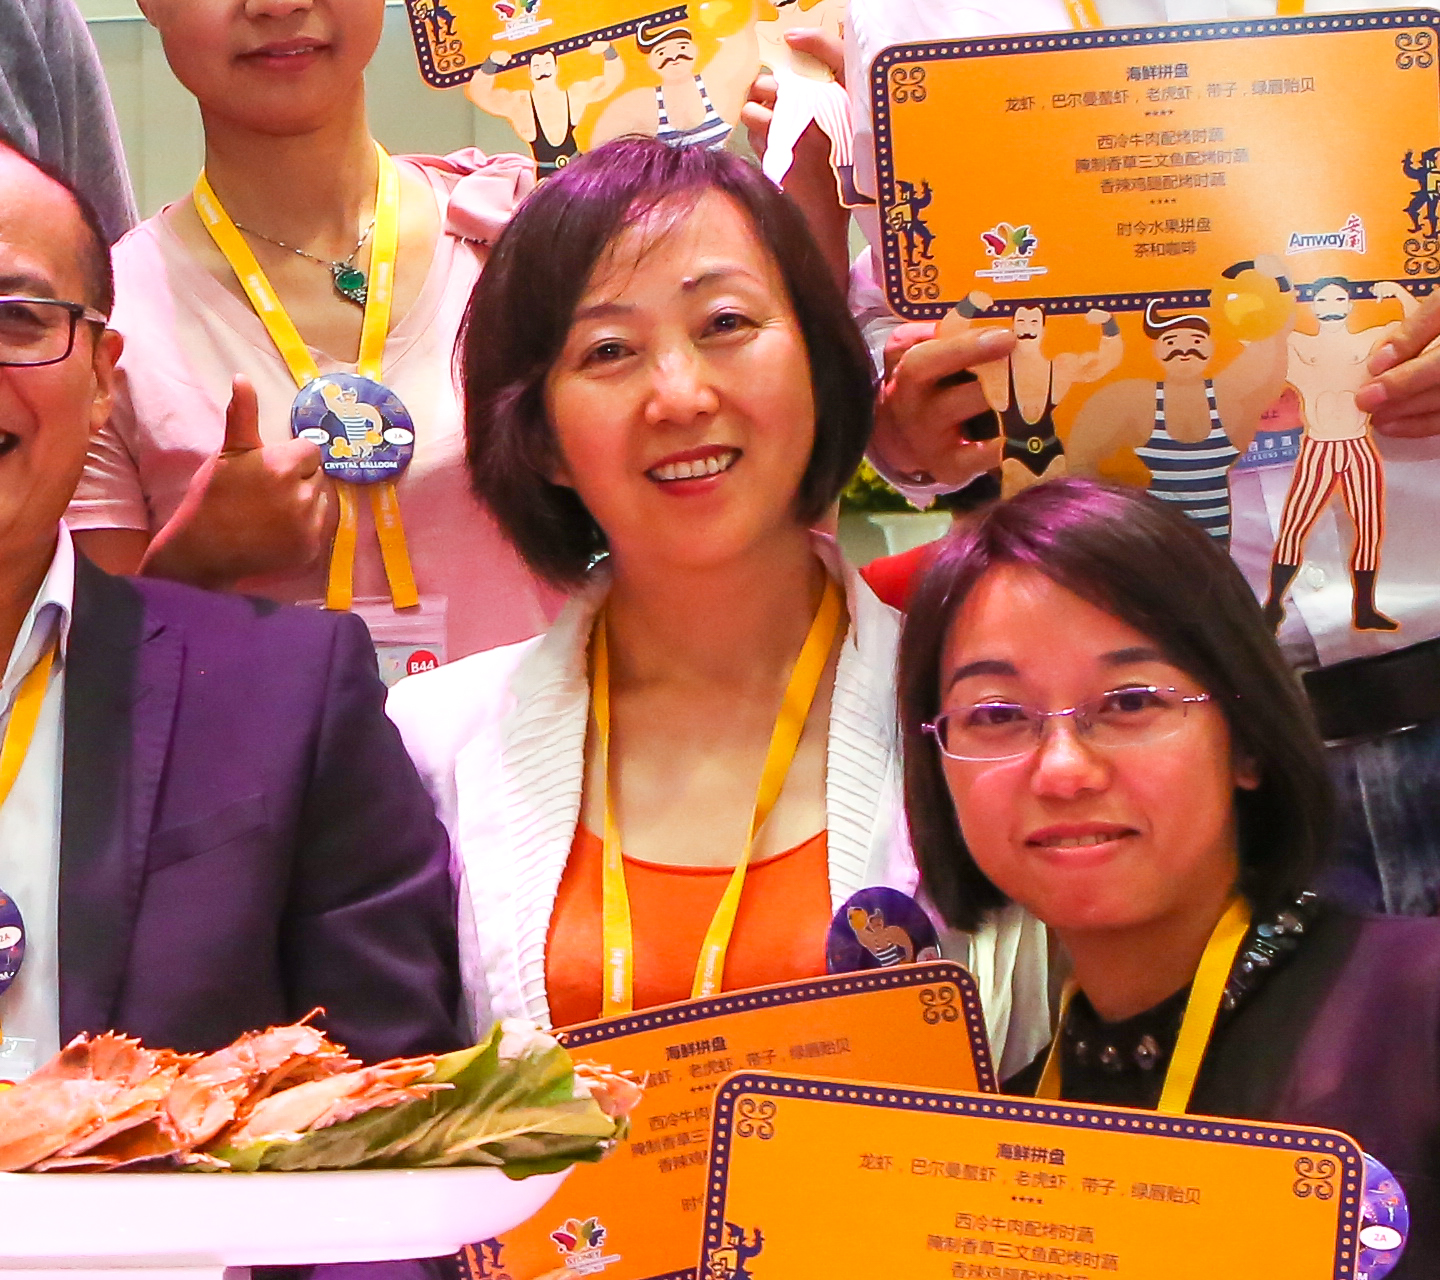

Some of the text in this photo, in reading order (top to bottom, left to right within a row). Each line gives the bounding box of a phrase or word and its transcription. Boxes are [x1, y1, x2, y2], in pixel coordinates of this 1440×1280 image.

[1125, 62, 1189, 83] 海鲜拼盘
[1117, 217, 1212, 240] 时令水果拼盘
[1289, 230, 1345, 252] Amway
[411, 660, 435, 673] B44
[1374, 1233, 1387, 1242] 2A
